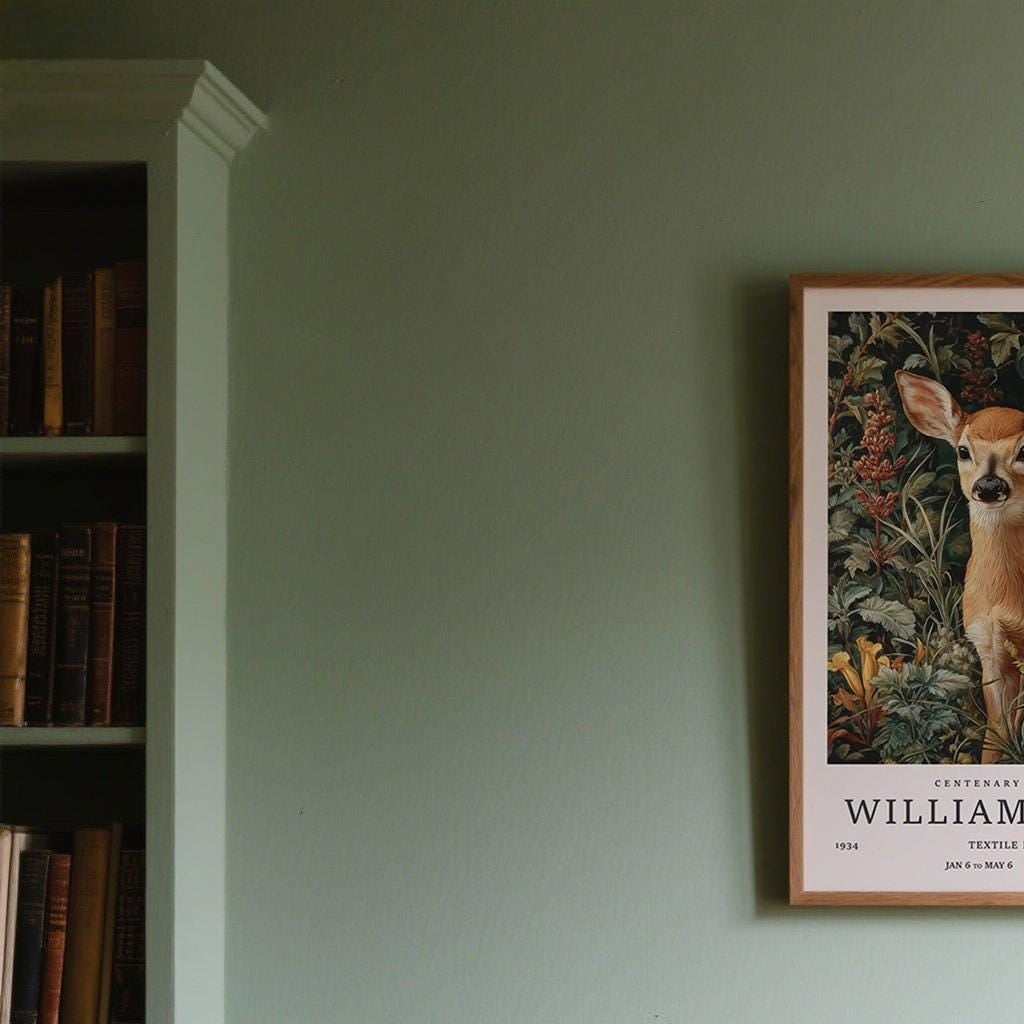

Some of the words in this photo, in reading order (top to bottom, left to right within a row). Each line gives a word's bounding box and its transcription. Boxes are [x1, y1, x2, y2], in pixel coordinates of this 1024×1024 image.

[934, 779, 1020, 788] CENTENARY
[835, 841, 859, 851] 1934
[967, 840, 1019, 850] TEXTILE
[944, 861, 963, 871] JAN
[964, 860, 971, 870] 6
[984, 861, 1005, 870] MAY
[1006, 860, 1014, 870] 6
